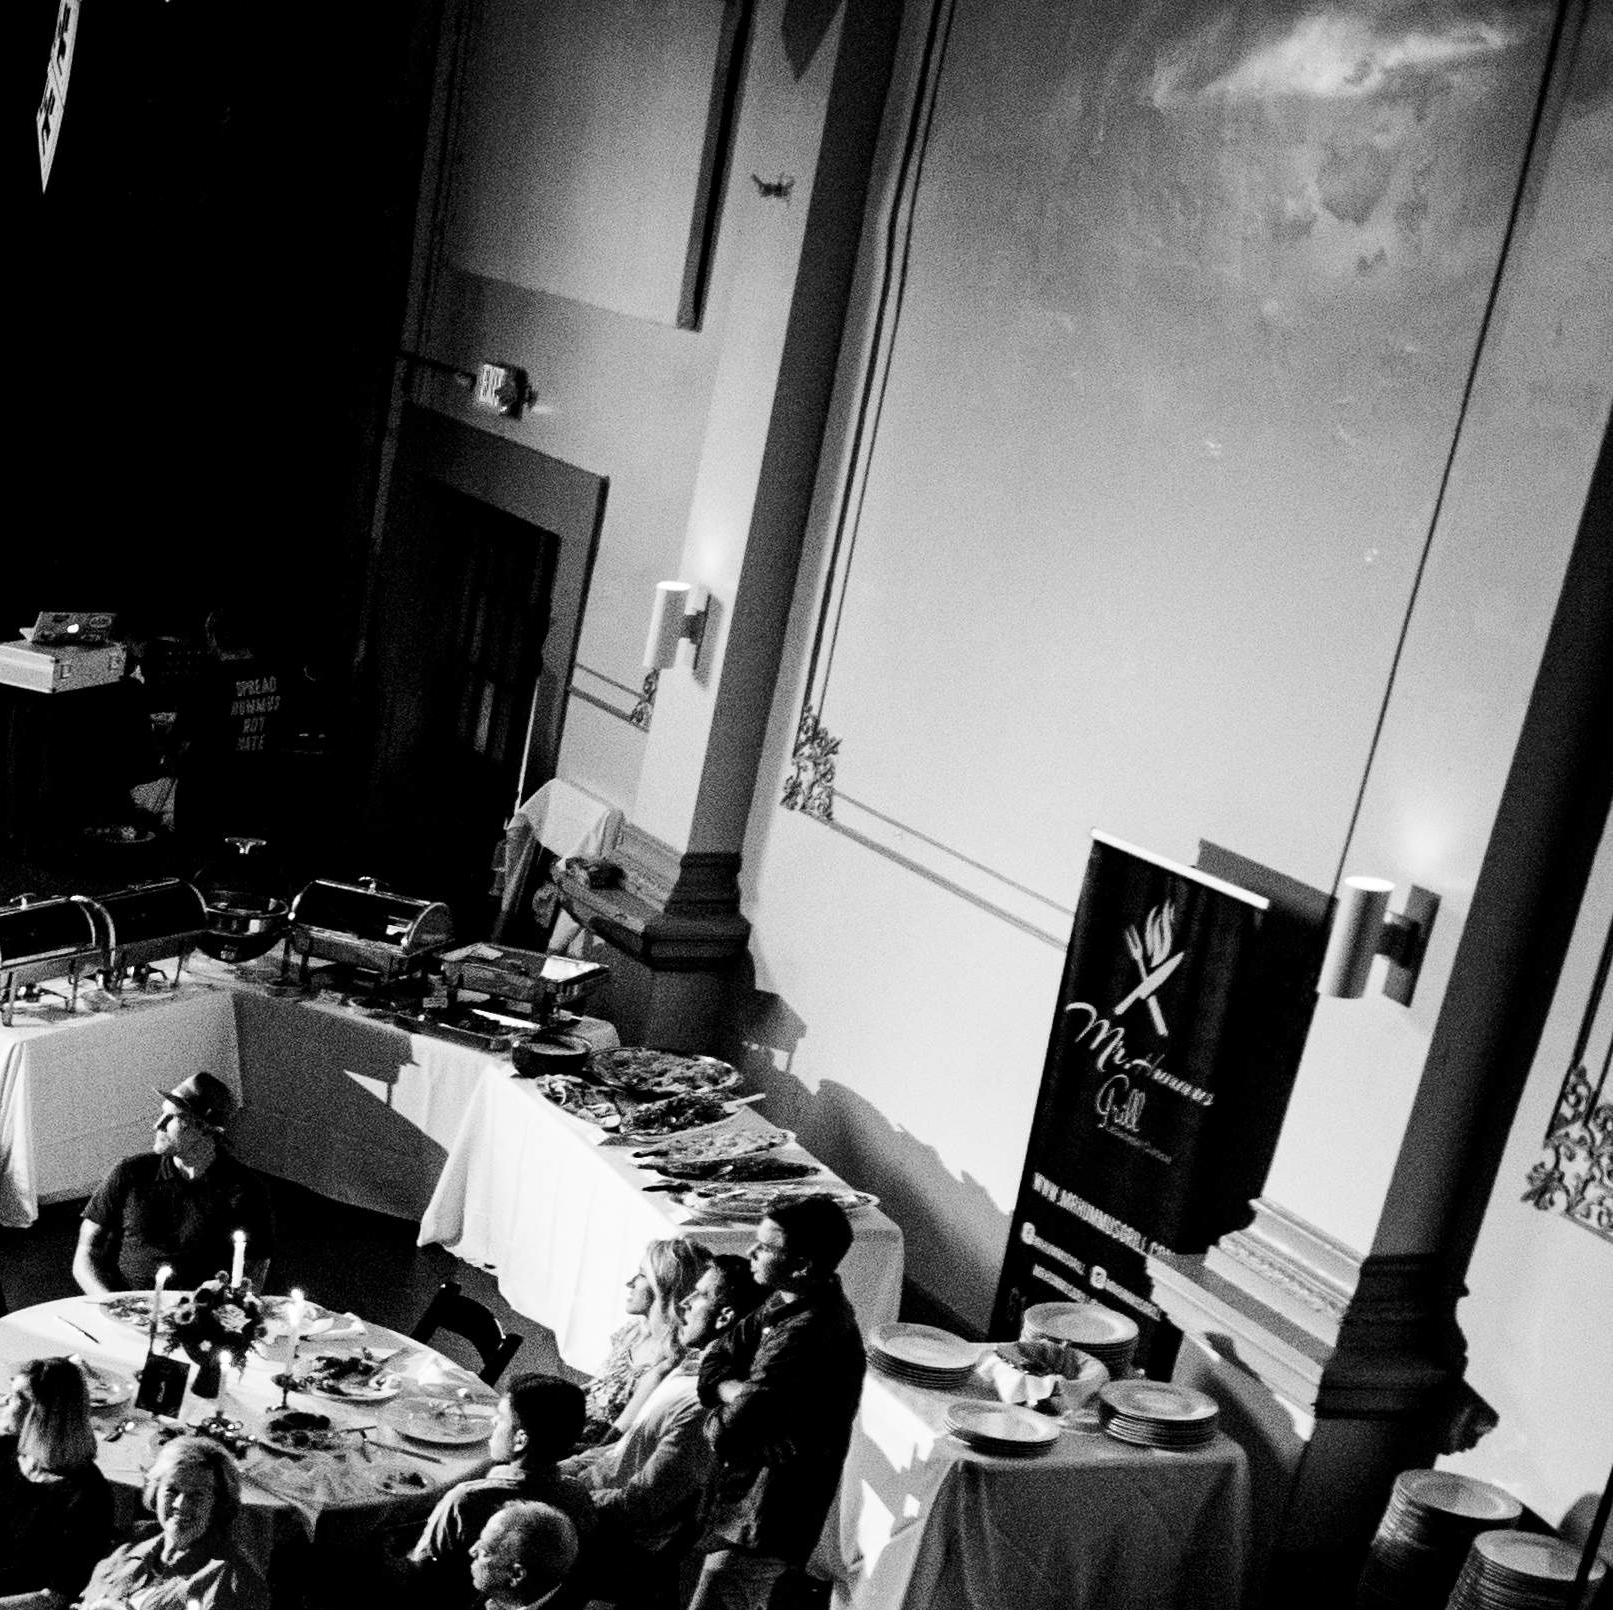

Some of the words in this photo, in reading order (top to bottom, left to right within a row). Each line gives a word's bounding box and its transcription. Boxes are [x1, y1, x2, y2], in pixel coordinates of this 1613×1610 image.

[235, 675, 277, 697] SPREAD
[231, 695, 281, 717] HUMMUS
[243, 716, 266, 734] NOT
[235, 733, 266, 751] HATE
[1065, 1001, 1131, 1073] Mr.
[1131, 1053, 1215, 1107] Hummus
[1095, 1073, 1146, 1129] Grill
